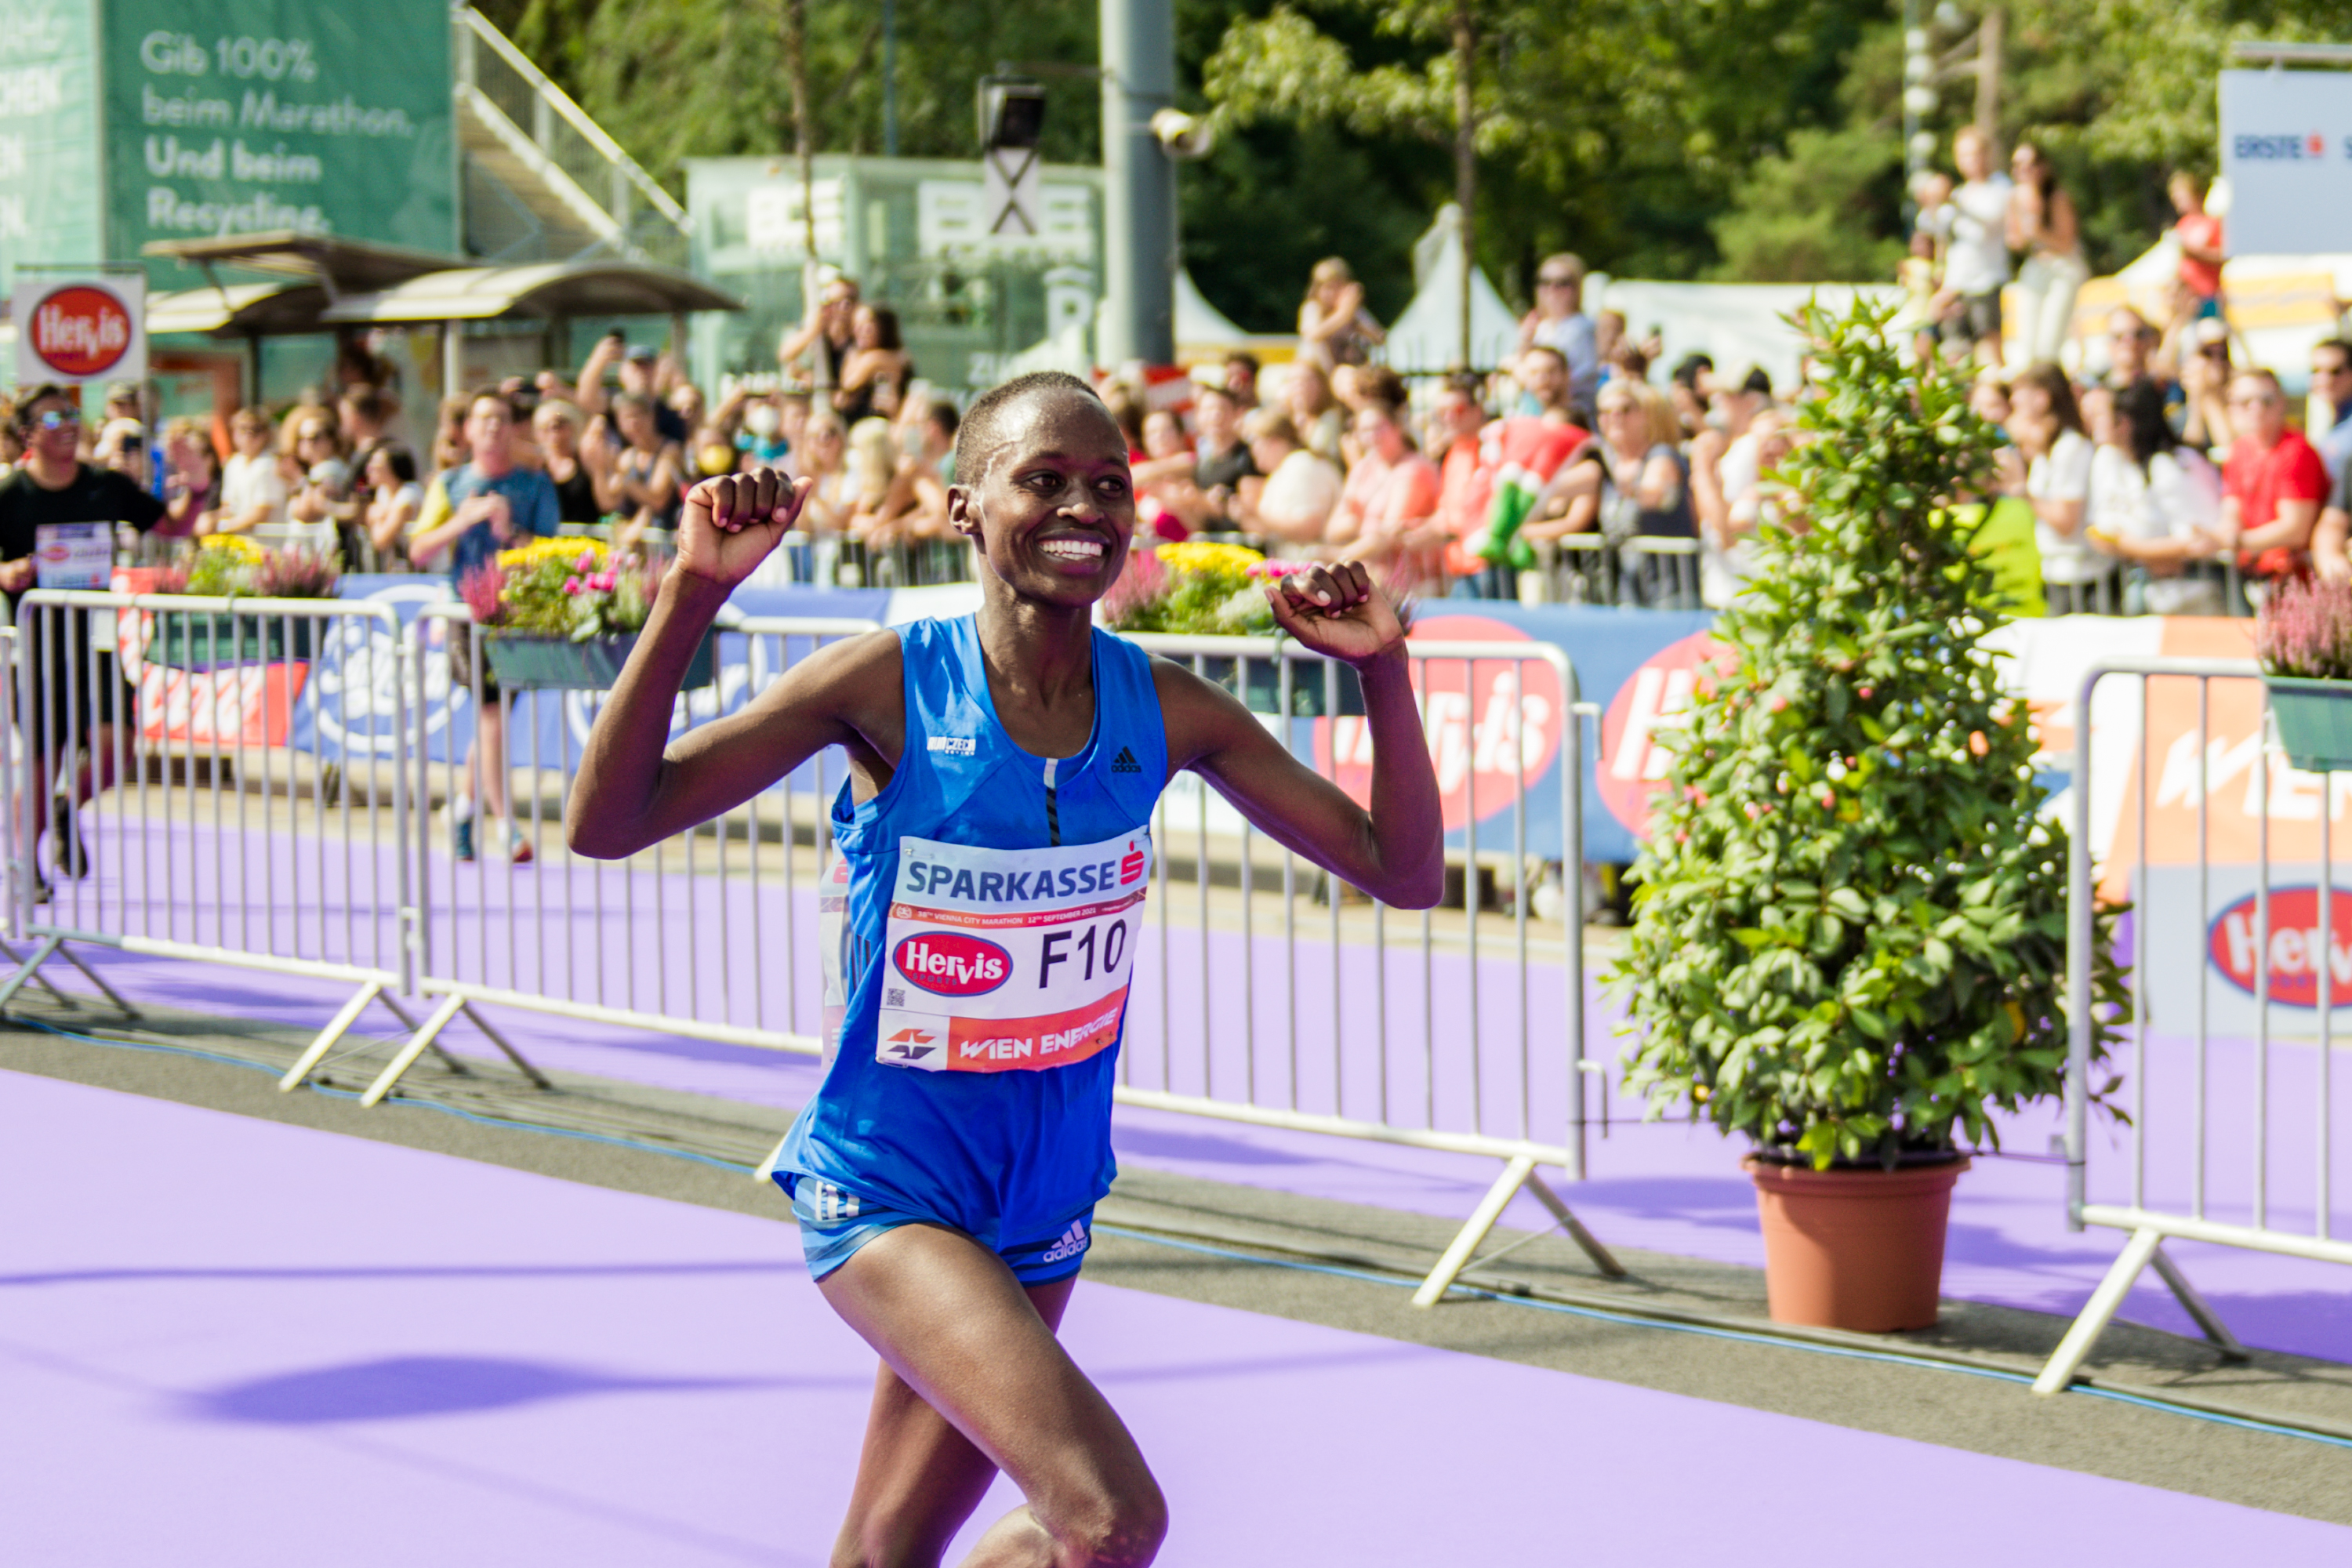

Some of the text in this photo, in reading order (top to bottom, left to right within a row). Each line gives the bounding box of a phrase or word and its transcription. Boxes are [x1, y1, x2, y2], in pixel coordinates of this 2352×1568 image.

[140, 30, 319, 83] Gib 100%
[142, 82, 419, 138] beim Marathon.
[144, 134, 323, 185] Und beim
[39, 303, 126, 361] Hervis
[1111, 761, 1142, 773] adidas
[906, 860, 1116, 902] SPARKASSE
[935, 913, 962, 923] VIENNA
[982, 916, 1023, 925] MARATHON
[1043, 909, 1081, 923] SEPTEMBER
[906, 941, 1004, 985] Hervis
[1039, 919, 1126, 989] F10
[2224, 912, 2352, 985] Herv
[913, 972, 957, 985] SPORTS
[960, 1007, 1118, 1059] WIEN ENERGIE
[1043, 1236, 1087, 1262] adidas
